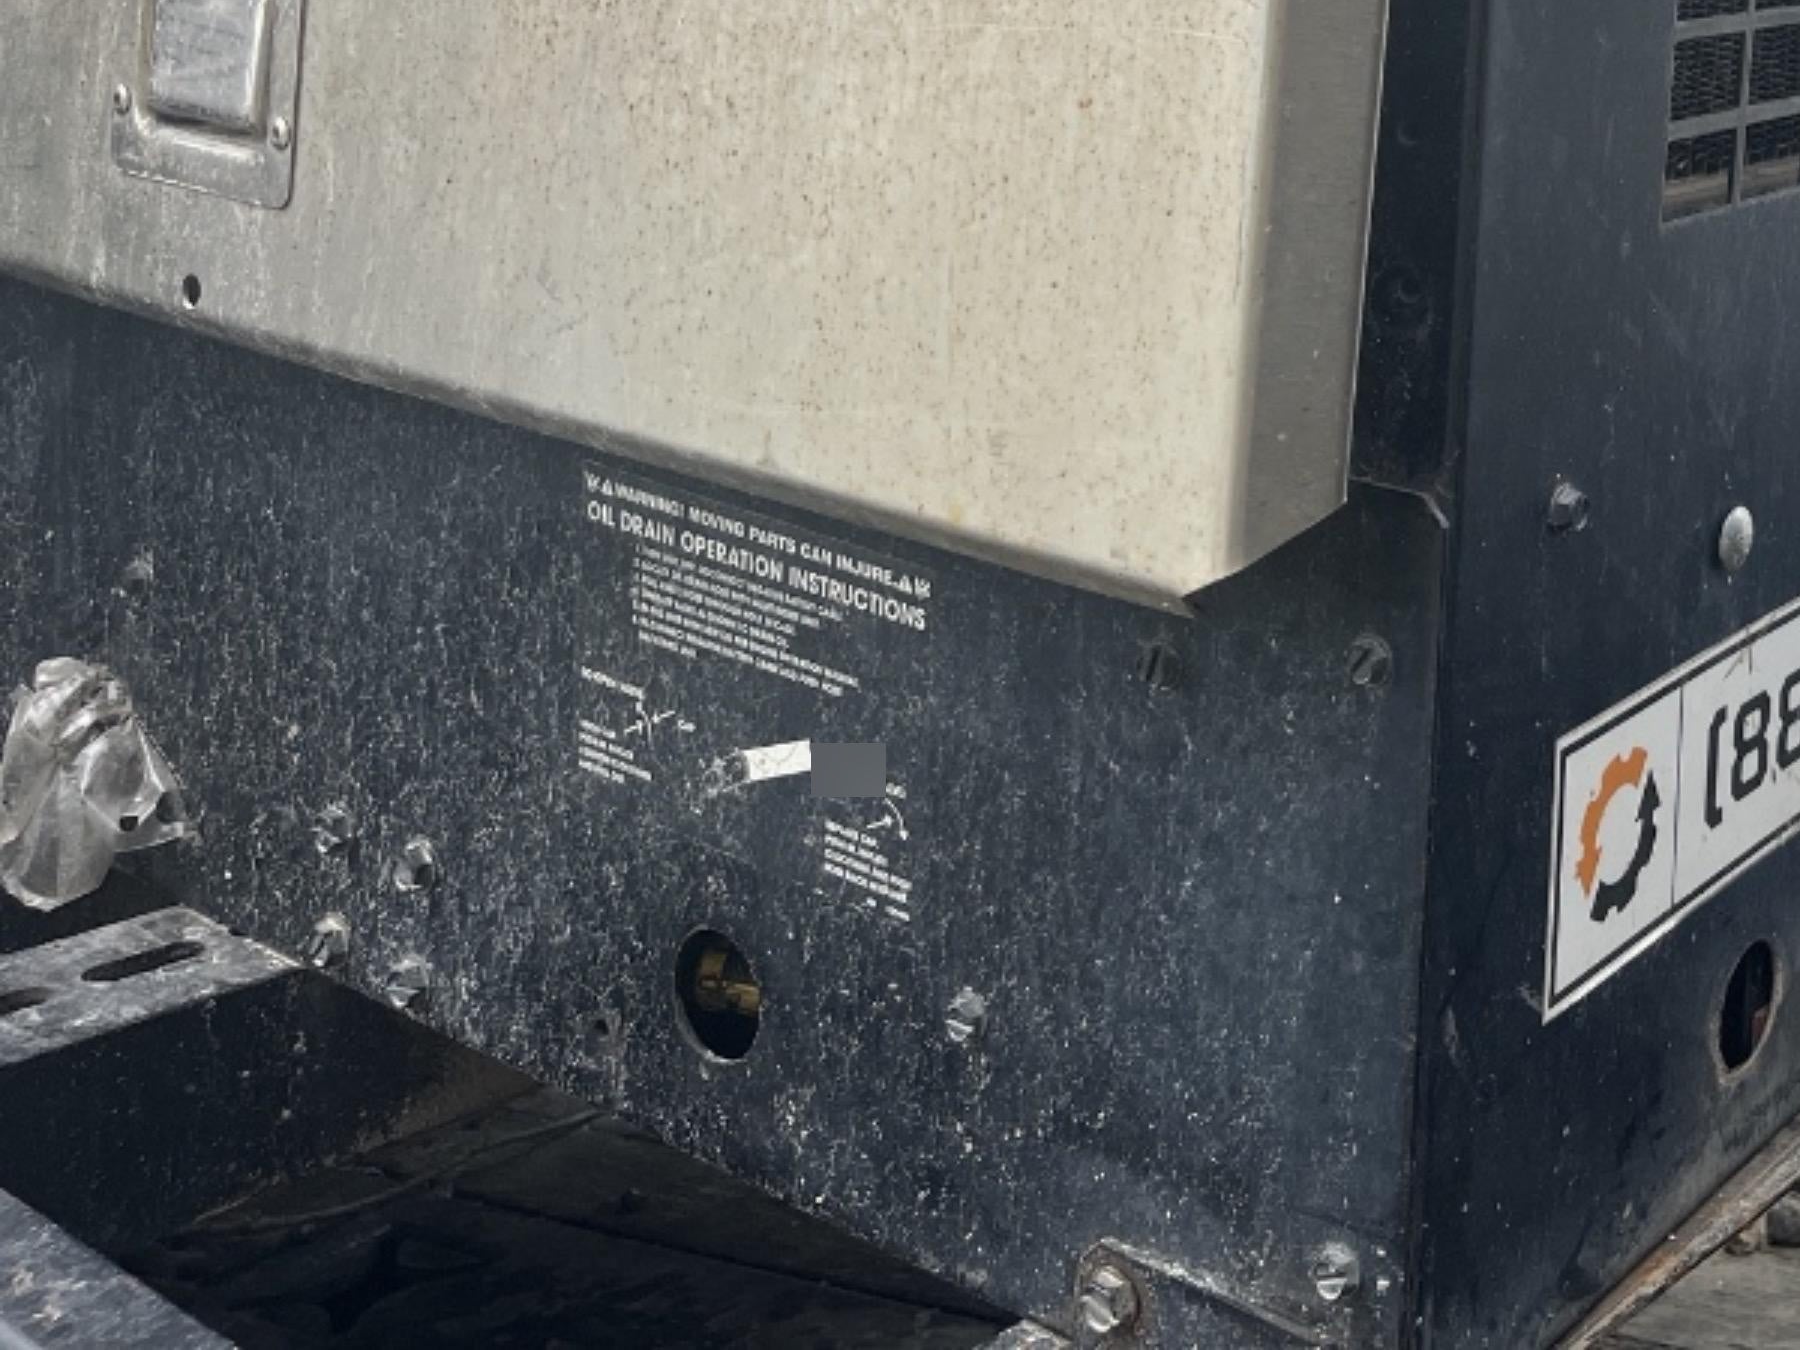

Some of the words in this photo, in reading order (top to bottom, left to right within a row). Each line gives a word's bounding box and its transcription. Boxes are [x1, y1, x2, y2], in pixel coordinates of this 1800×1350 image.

[587, 500, 616, 528] OIL
[620, 509, 676, 546] DRAIN
[680, 529, 784, 584] OPERATION
[788, 566, 927, 632] INSTRUCTIONS
[688, 505, 745, 538] MOVING
[750, 526, 796, 554] PARTS
